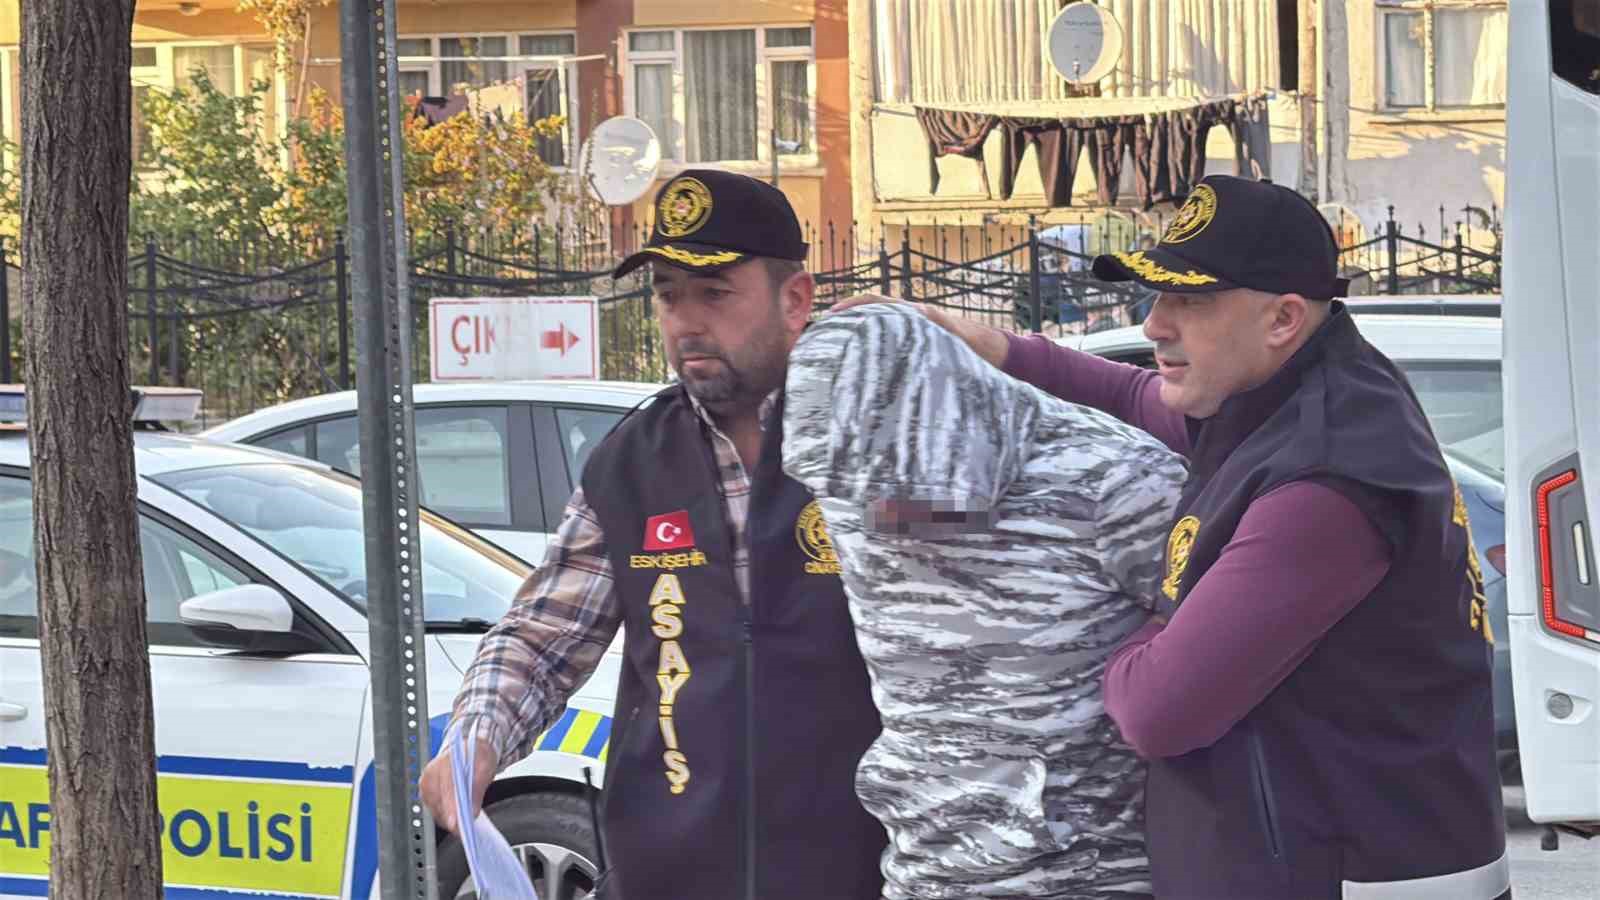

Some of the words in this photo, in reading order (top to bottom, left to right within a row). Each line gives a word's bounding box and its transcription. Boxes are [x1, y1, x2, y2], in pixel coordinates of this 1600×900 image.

[451, 314, 511, 367] ÇIK
[648, 573, 690, 794] ASAYİŞ
[0, 801, 49, 848] AF
[159, 801, 312, 862] OLİSİ
